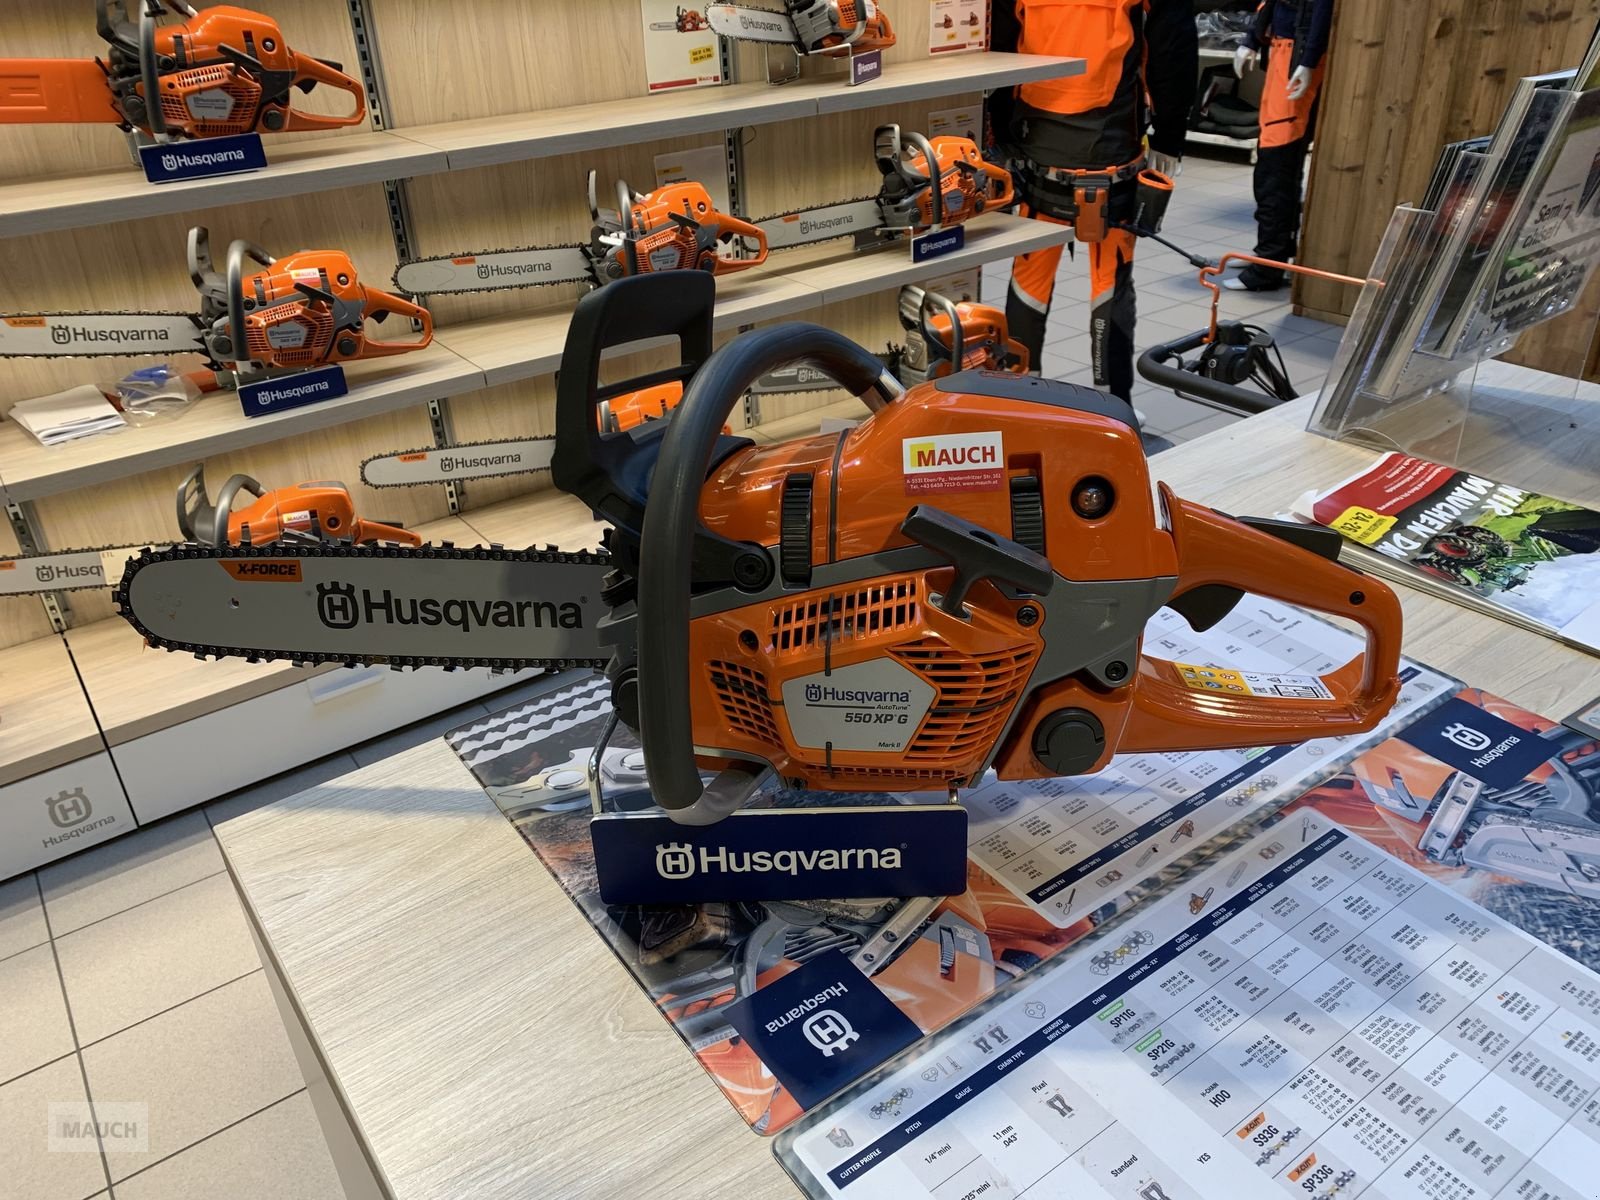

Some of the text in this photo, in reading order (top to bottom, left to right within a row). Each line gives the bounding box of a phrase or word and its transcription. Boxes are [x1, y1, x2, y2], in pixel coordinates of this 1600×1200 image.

[752, 20, 783, 33] Husqvarna
[177, 148, 244, 167] Husqvarna
[809, 214, 853, 232] Husqvarna
[926, 236, 957, 252] Husqvarna
[491, 261, 552, 278] Husqvarna
[73, 327, 168, 345] Husqvarna
[270, 382, 329, 402] Husqvarna
[455, 454, 521, 469] Husqvarna
[917, 445, 996, 467] MAUCH
[1405, 467, 1495, 545] MAUCHEN
[1478, 475, 1531, 525] WIR
[237, 564, 297, 576] X-FORCE
[844, 712, 872, 724] 550
[898, 714, 908, 724] G
[1470, 734, 1522, 769] Husqvarna
[42, 814, 116, 849] Husqvarna
[1077, 856, 1100, 873] FILING GUIDE
[1037, 882, 1056, 896] DIAMETER
[1127, 968, 1141, 981] CHAIN
[764, 981, 849, 1035] Husqvarna
[1092, 992, 1107, 1006] CHAIN
[1042, 1017, 1064, 1036] GUARDED
[1109, 1005, 1136, 1030] SP11G
[1046, 1029, 1060, 1041] DRIVE
[1146, 1035, 1176, 1062] SP21G
[996, 1048, 1025, 1071] CHAIN TYPE
[954, 1085, 972, 1101] GAUGE
[1031, 1079, 1048, 1094] Pixel
[1199, 1080, 1219, 1098] H-CHAIN
[905, 1119, 922, 1134] PITCH
[999, 1124, 1013, 1136] mm
[1252, 1123, 1279, 1147] S93G
[1445, 1127, 1460, 1142] H-CHAIN
[839, 1146, 882, 1180] CUTTER PROFILE
[1110, 1153, 1138, 1178] Standard
[1197, 1151, 1211, 1165] YES
[1301, 1162, 1333, 1193] SP33G
